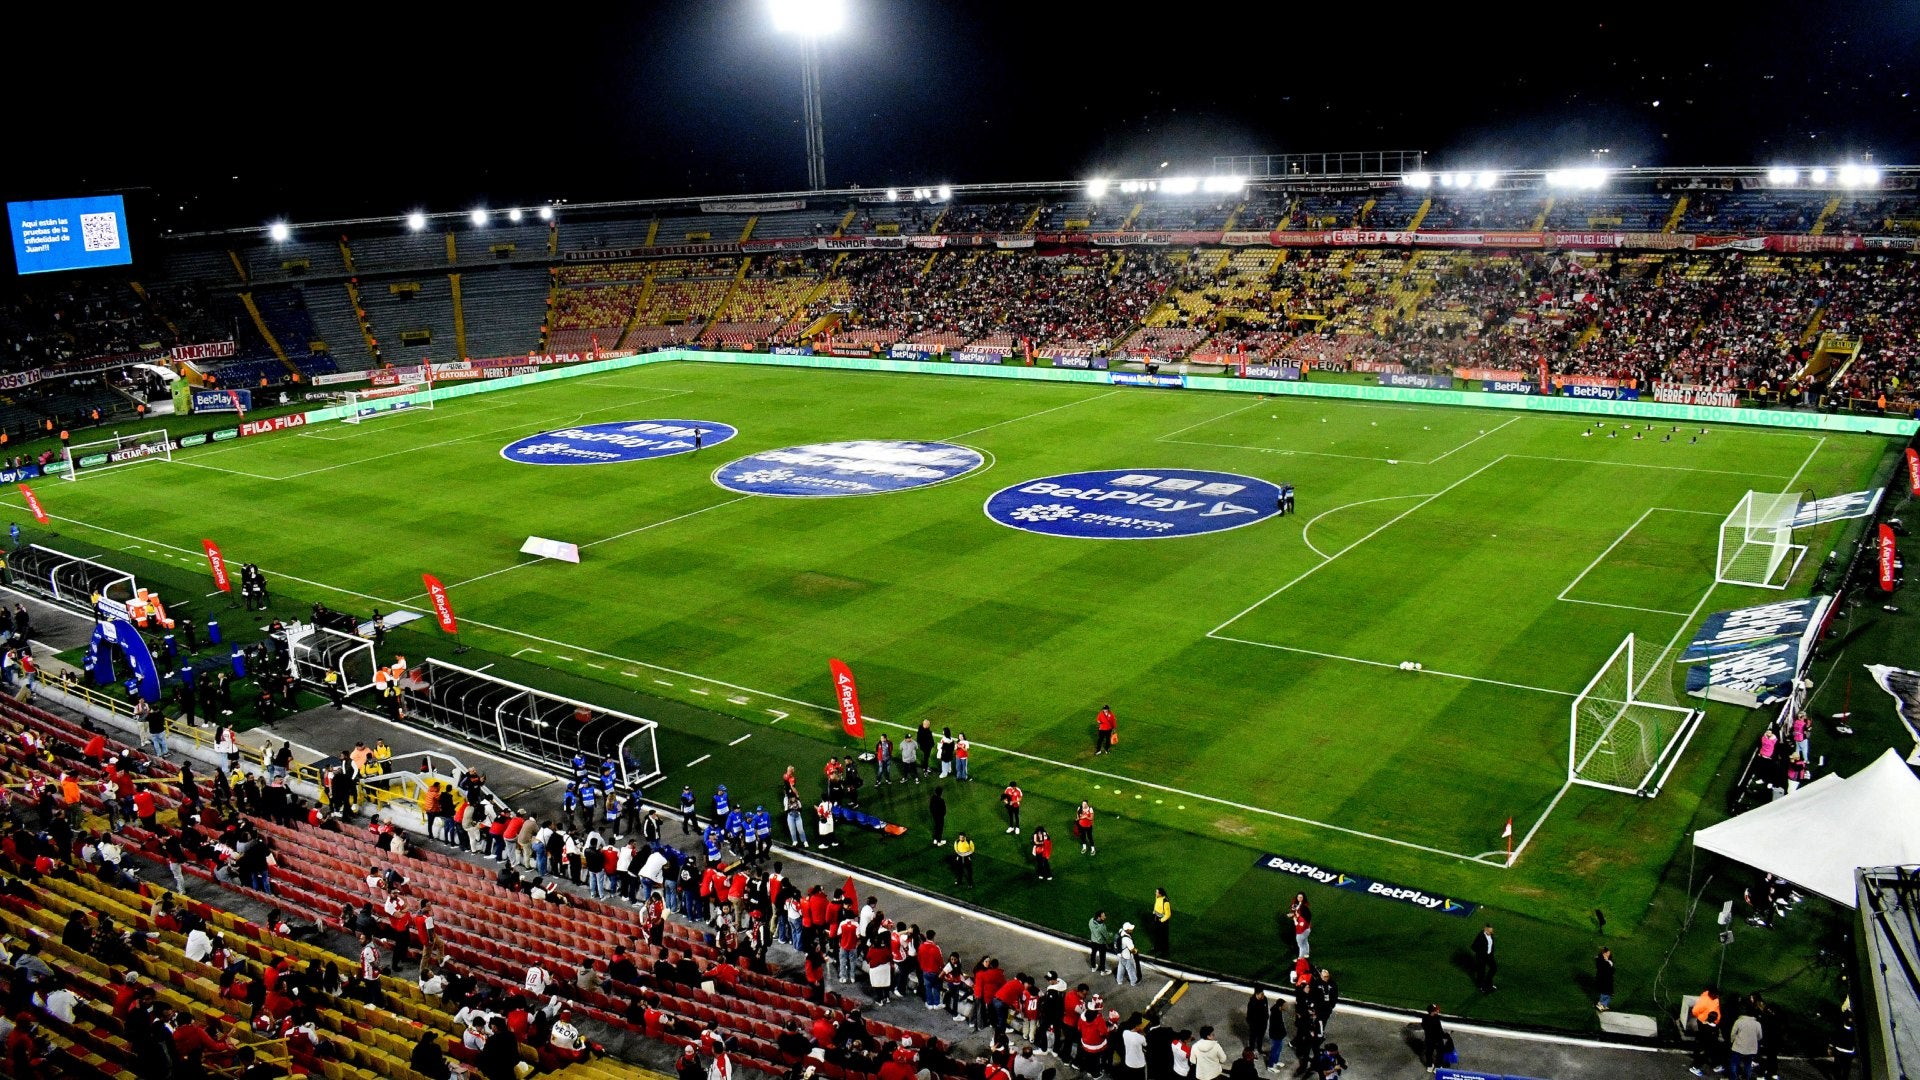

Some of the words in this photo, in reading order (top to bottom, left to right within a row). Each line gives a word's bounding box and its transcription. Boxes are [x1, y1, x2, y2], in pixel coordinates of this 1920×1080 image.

[39, 218, 57, 227] están
[58, 217, 68, 225] las
[23, 227, 50, 238] pruebas
[52, 226, 60, 234] de
[1336, 232, 1388, 243] BRRA
[24, 236, 60, 245] infidelidad
[1556, 235, 1582, 244] CAPITAL
[1583, 235, 1595, 244] DEL
[1596, 234, 1613, 245] LEÓN
[528, 355, 553, 364] FILA
[555, 353, 580, 363] FILA
[891, 350, 917, 361] BetPlay
[959, 352, 986, 363] BetPlay
[1061, 356, 1091, 369] BetPlay
[439, 370, 479, 379] GATORADE
[483, 366, 504, 378] PIERRE
[1245, 367, 1280, 378] BetPlay
[1391, 374, 1429, 388] BetPlay
[1226, 379, 1294, 394] CAMISETAS
[1297, 382, 1359, 398] OVERSIZE
[1397, 387, 1464, 403] ALGODON
[1494, 382, 1532, 395] BetPlay
[1573, 386, 1616, 400] BetPlay
[196, 393, 232, 405] BetPlay
[1654, 386, 1683, 403] PIERRE
[1694, 389, 1738, 407] AGOSTINY
[1525, 396, 1609, 414] CAMISETAS
[1612, 400, 1689, 417] OVERSIZE
[1692, 405, 1733, 421] 100%
[1738, 409, 1820, 428] ALGODON
[242, 421, 273, 436] FILA
[275, 414, 304, 430] FILA
[111, 449, 142, 463] NECTAR
[148, 441, 178, 456] NECTAR
[1019, 483, 1207, 512] BetPlay
[1071, 517, 1164, 533] COLOMBIA
[1079, 512, 1175, 531] DIMAYOR
[210, 555, 226, 586] BetPlay
[1882, 546, 1892, 583] BetPlay
[436, 593, 452, 625] BetPlay
[841, 683, 857, 727] BetPlay
[1267, 856, 1338, 884] BetPlay
[1367, 881, 1443, 909] BetPlay
[527, 973, 538, 984] 18
[1027, 998, 1038, 1011] 10
